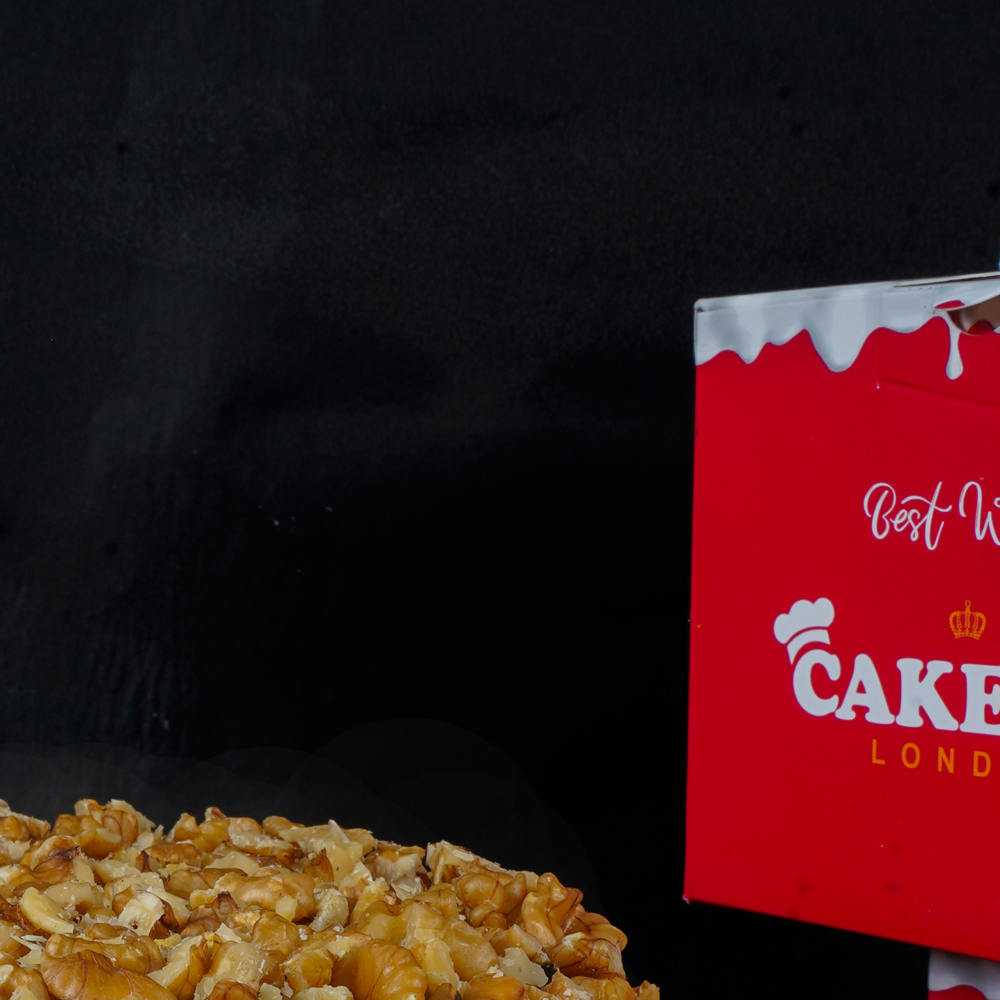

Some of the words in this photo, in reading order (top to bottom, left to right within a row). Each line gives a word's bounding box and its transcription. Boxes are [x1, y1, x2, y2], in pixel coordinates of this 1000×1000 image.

[863, 481, 952, 551] Best
[793, 649, 1000, 736] CAKE
[872, 738, 991, 778] LOND
